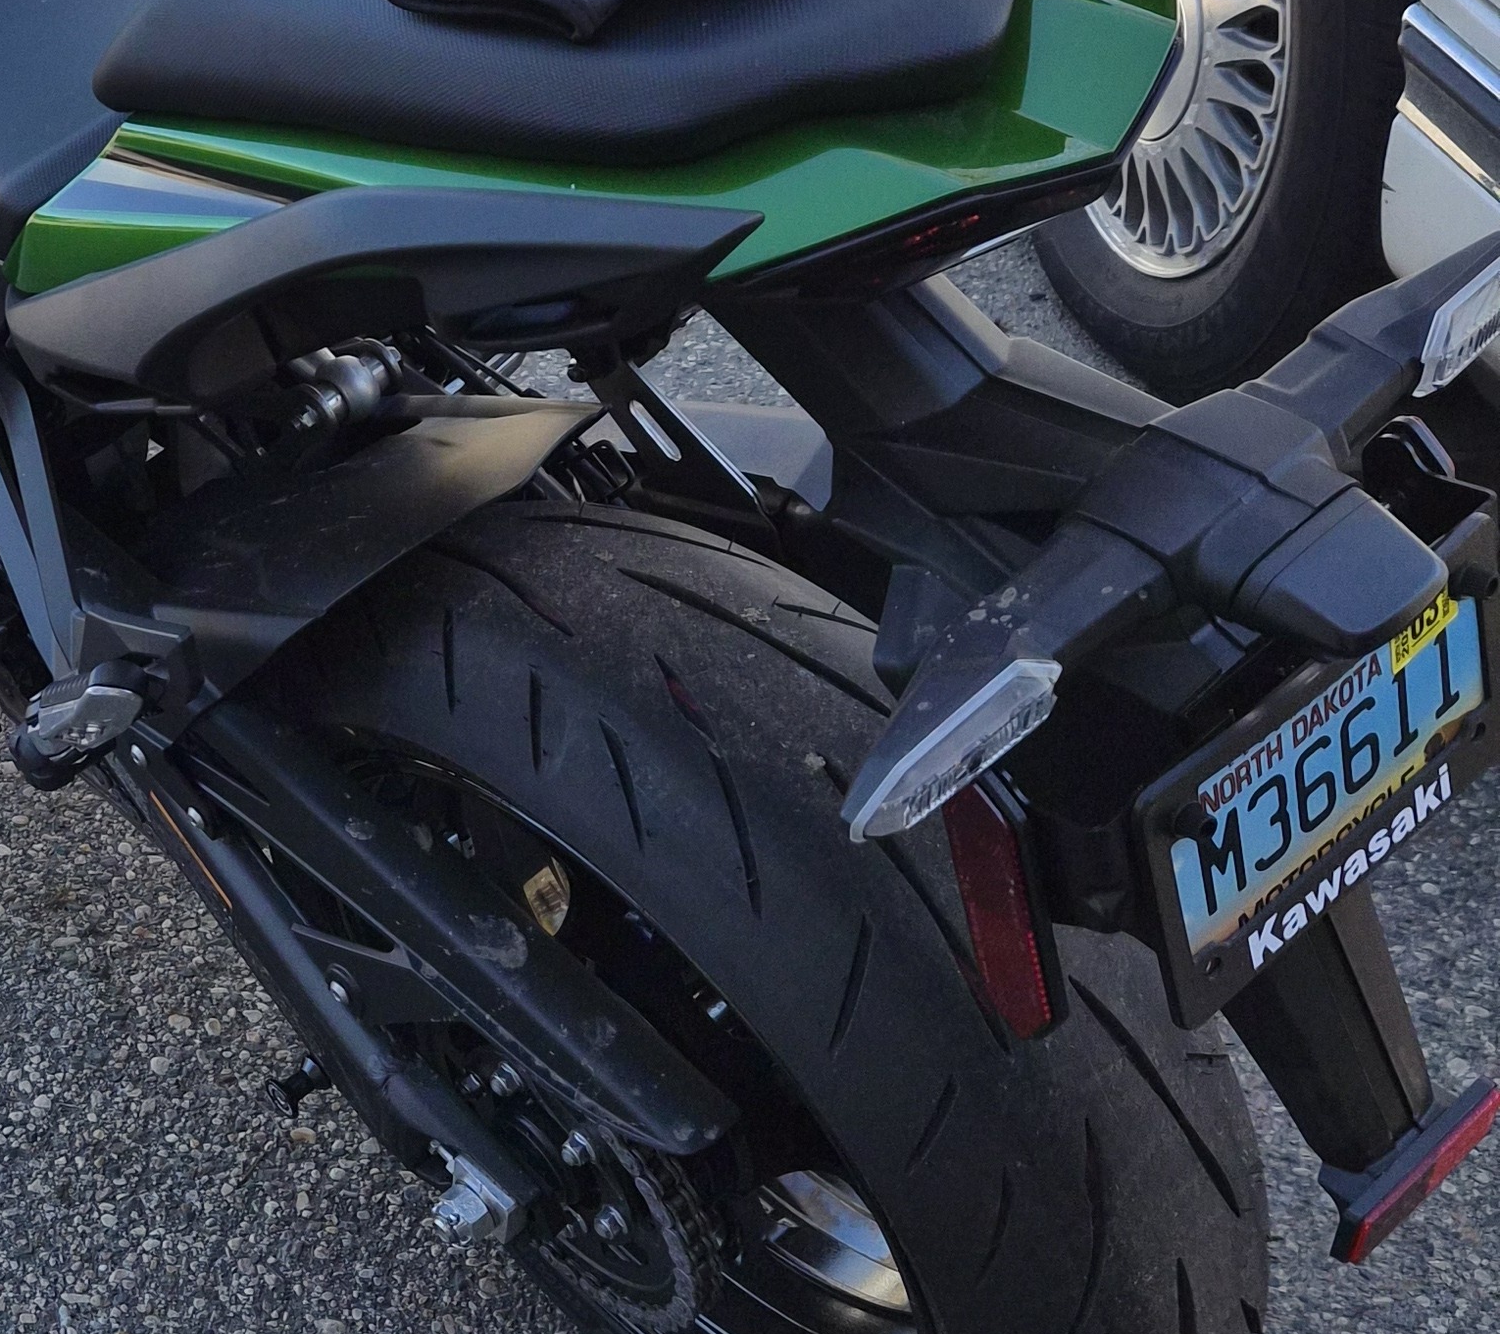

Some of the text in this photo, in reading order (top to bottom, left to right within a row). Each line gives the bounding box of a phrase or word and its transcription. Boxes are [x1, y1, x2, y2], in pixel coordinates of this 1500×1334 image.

[1196, 630, 1461, 918] M36611
[1199, 653, 1383, 813] NORTH DAKOTA
[1247, 762, 1453, 971] Kawasaki
